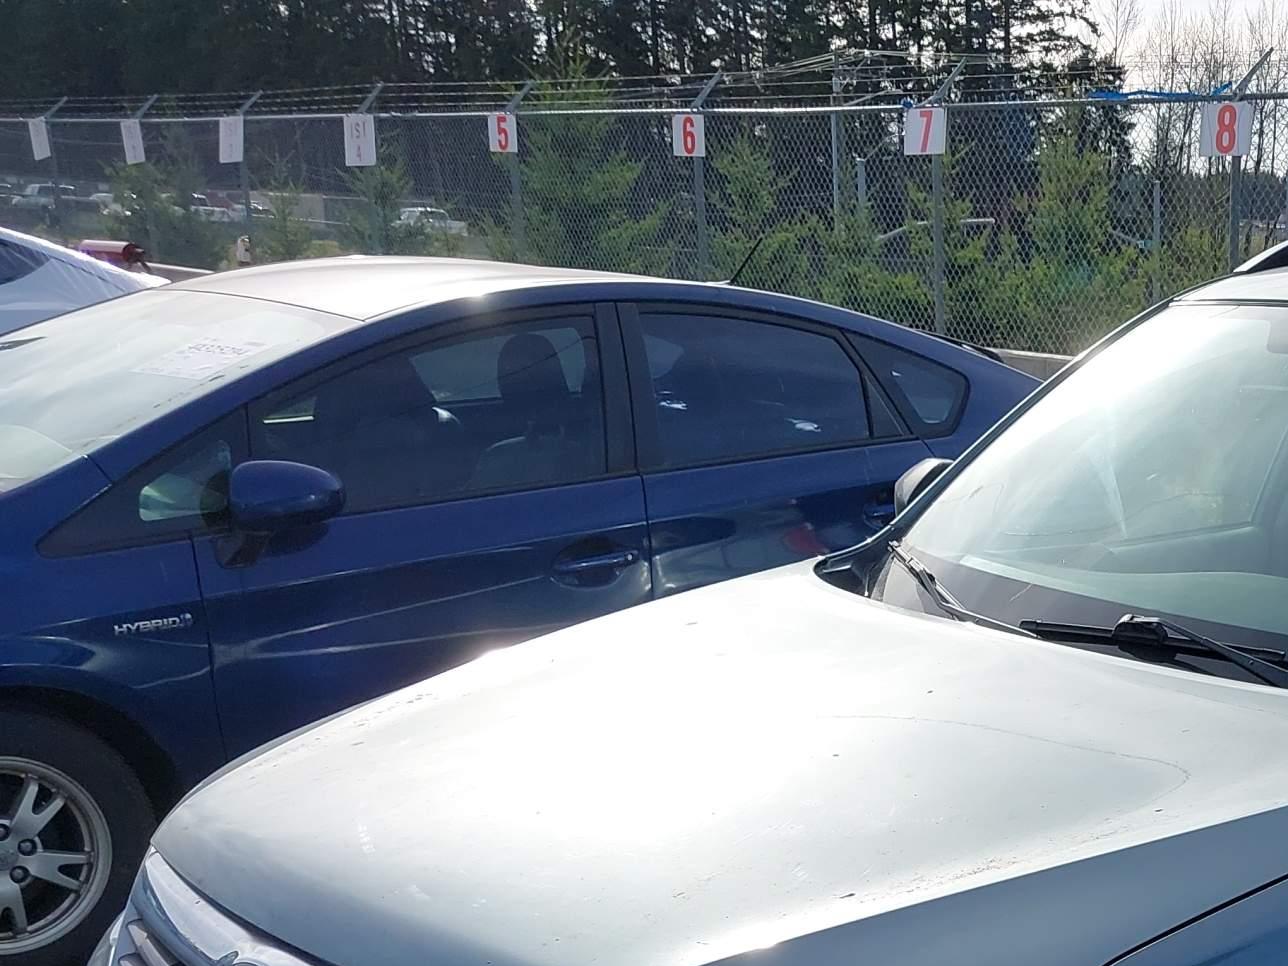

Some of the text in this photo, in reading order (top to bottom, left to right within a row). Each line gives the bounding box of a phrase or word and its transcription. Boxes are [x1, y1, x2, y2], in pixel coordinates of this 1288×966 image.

[496, 115, 509, 151] 5
[683, 116, 696, 154] 6
[920, 110, 933, 153] 7
[1216, 104, 1236, 154] 8
[113, 616, 181, 635] HYBRID
